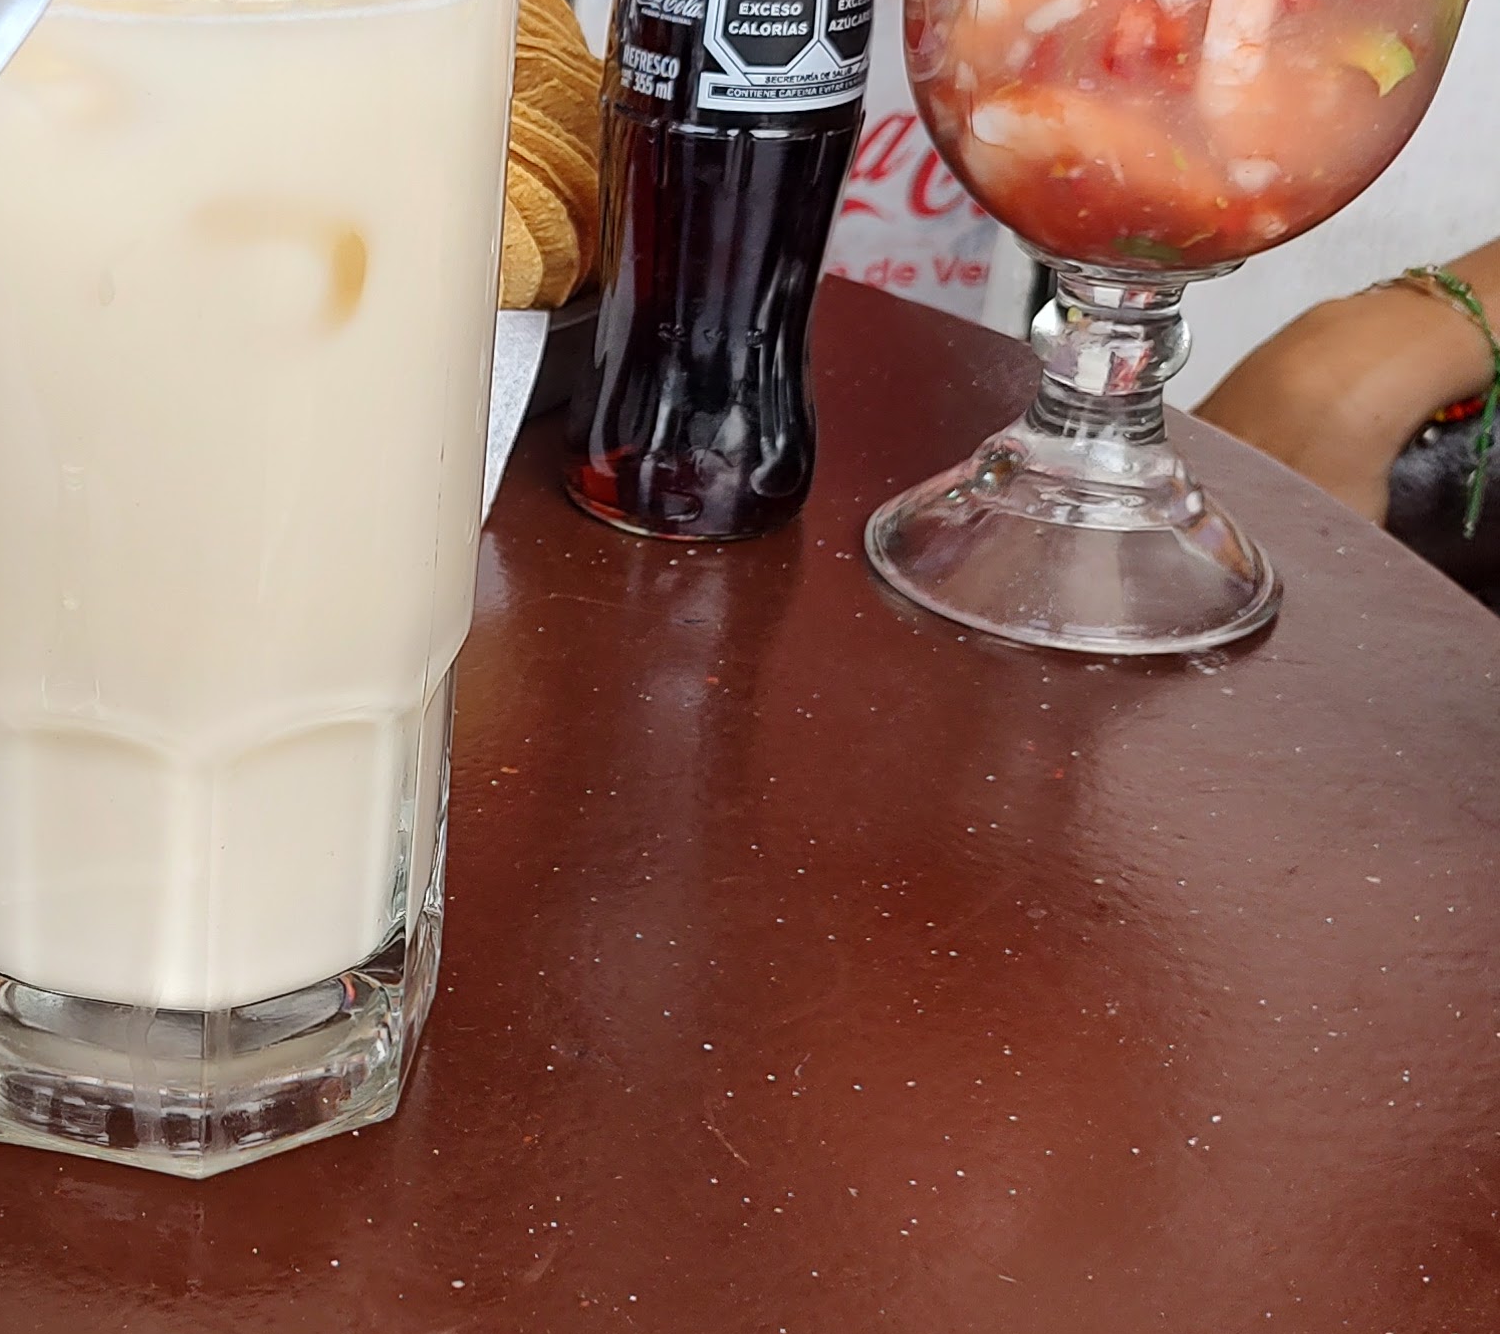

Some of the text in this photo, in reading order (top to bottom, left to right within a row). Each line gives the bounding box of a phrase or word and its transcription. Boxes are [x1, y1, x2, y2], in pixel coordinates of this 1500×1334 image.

[738, 2, 803, 16] EXCESO
[728, 20, 810, 36] CALORÍAS
[622, 44, 680, 80] REFRESCO
[820, 71, 831, 80] DE
[633, 72, 655, 95] 355
[726, 88, 777, 98] CONTIENE
[818, 84, 845, 95] EVITAR
